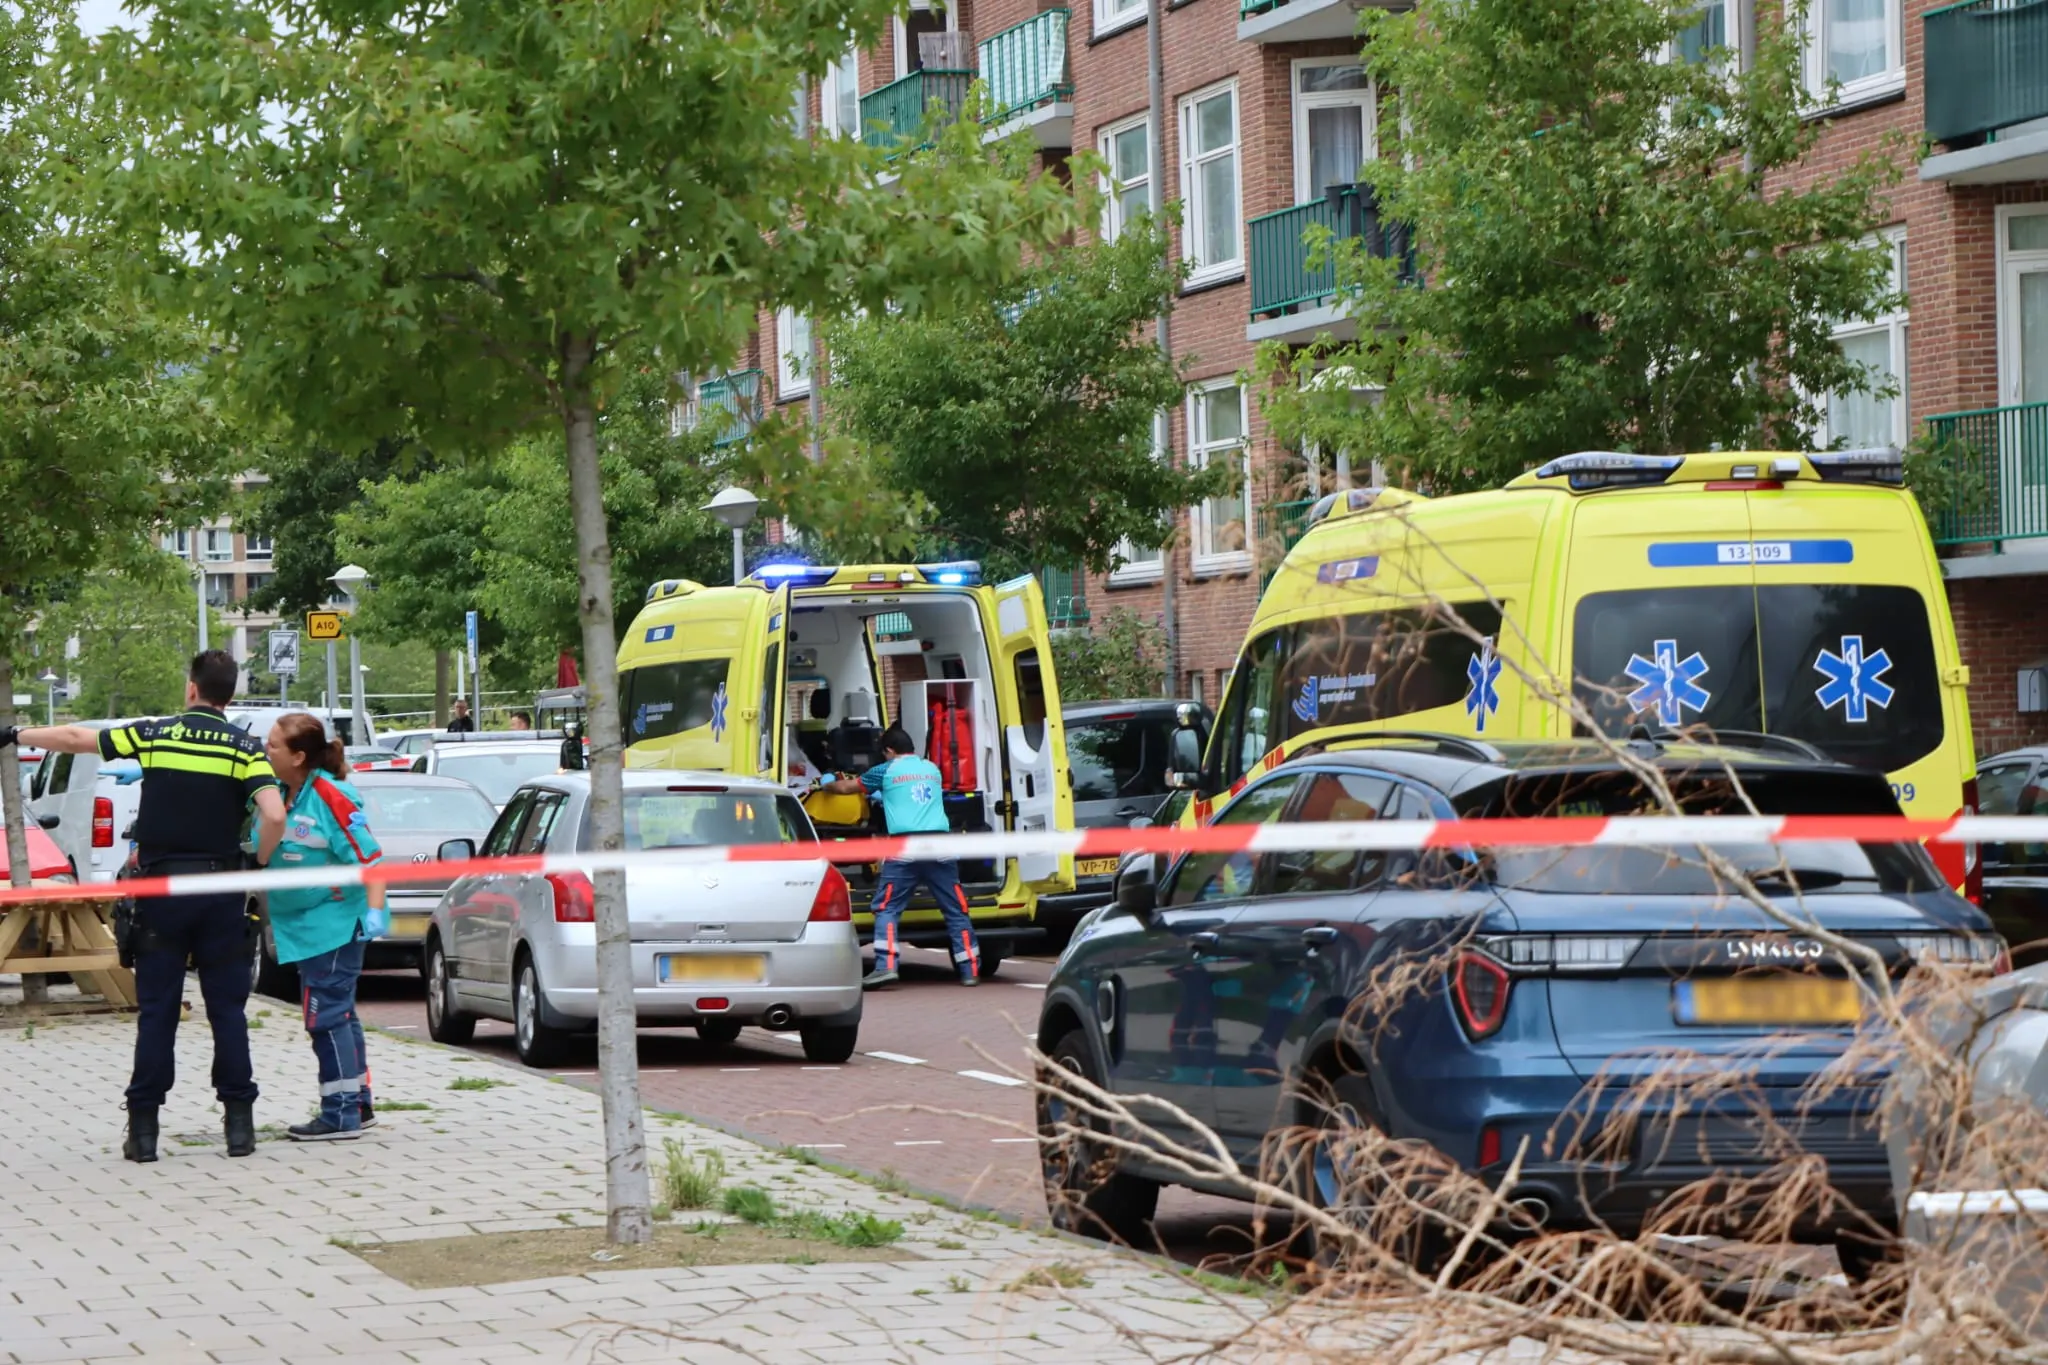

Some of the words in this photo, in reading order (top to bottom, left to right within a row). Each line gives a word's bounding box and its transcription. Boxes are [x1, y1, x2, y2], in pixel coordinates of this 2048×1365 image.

[1728, 546, 1781, 559] 13-109
[316, 621, 335, 630] A10
[162, 721, 229, 742] POLITIE
